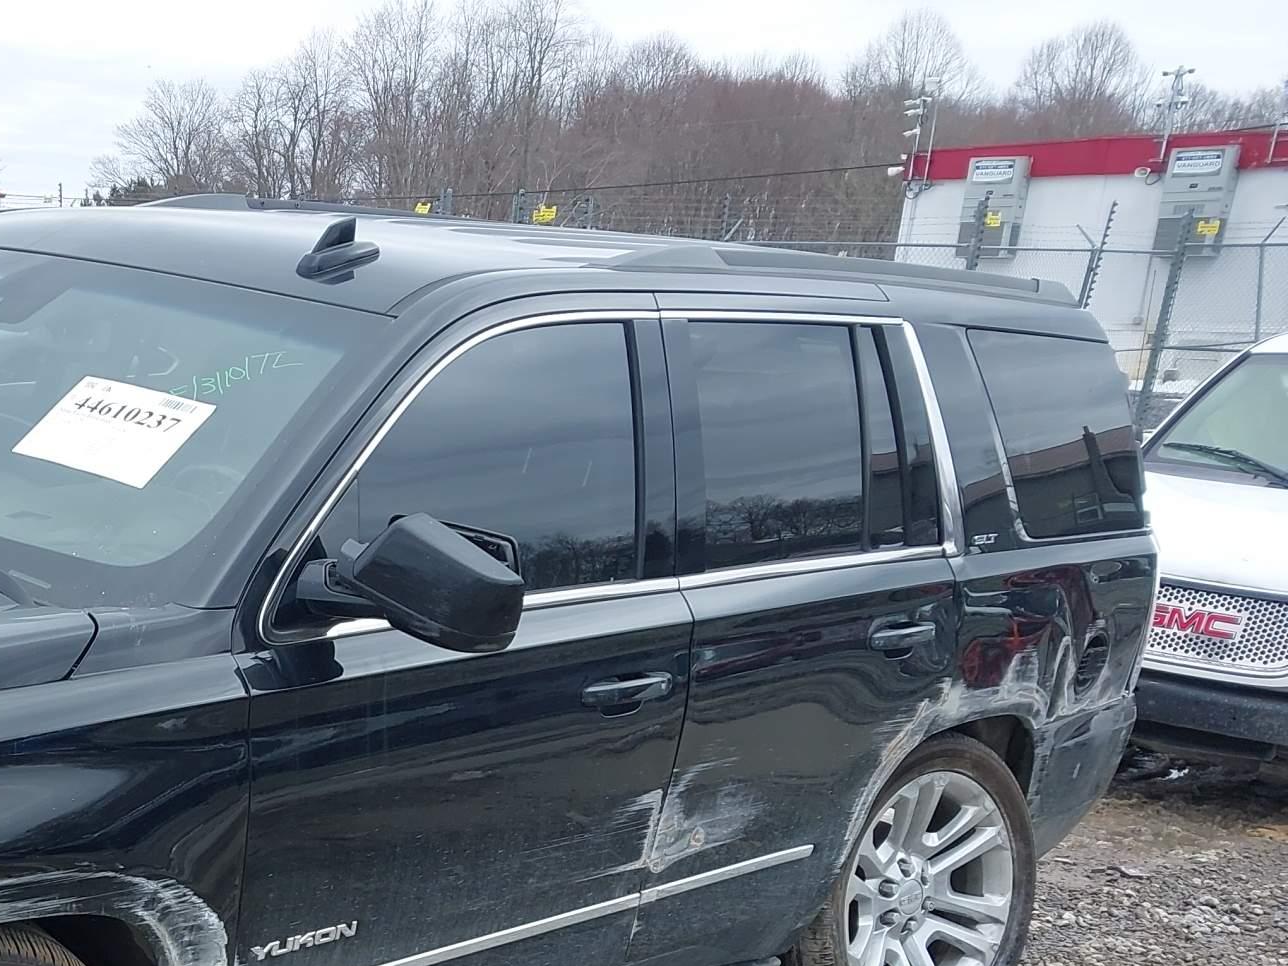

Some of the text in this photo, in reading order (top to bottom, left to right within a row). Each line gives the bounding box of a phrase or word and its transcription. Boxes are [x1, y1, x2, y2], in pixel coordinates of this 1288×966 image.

[74, 396, 182, 432] 44610237
[973, 533, 999, 545] SLT
[1153, 603, 1242, 640] GMC
[250, 920, 358, 961] YUKON
